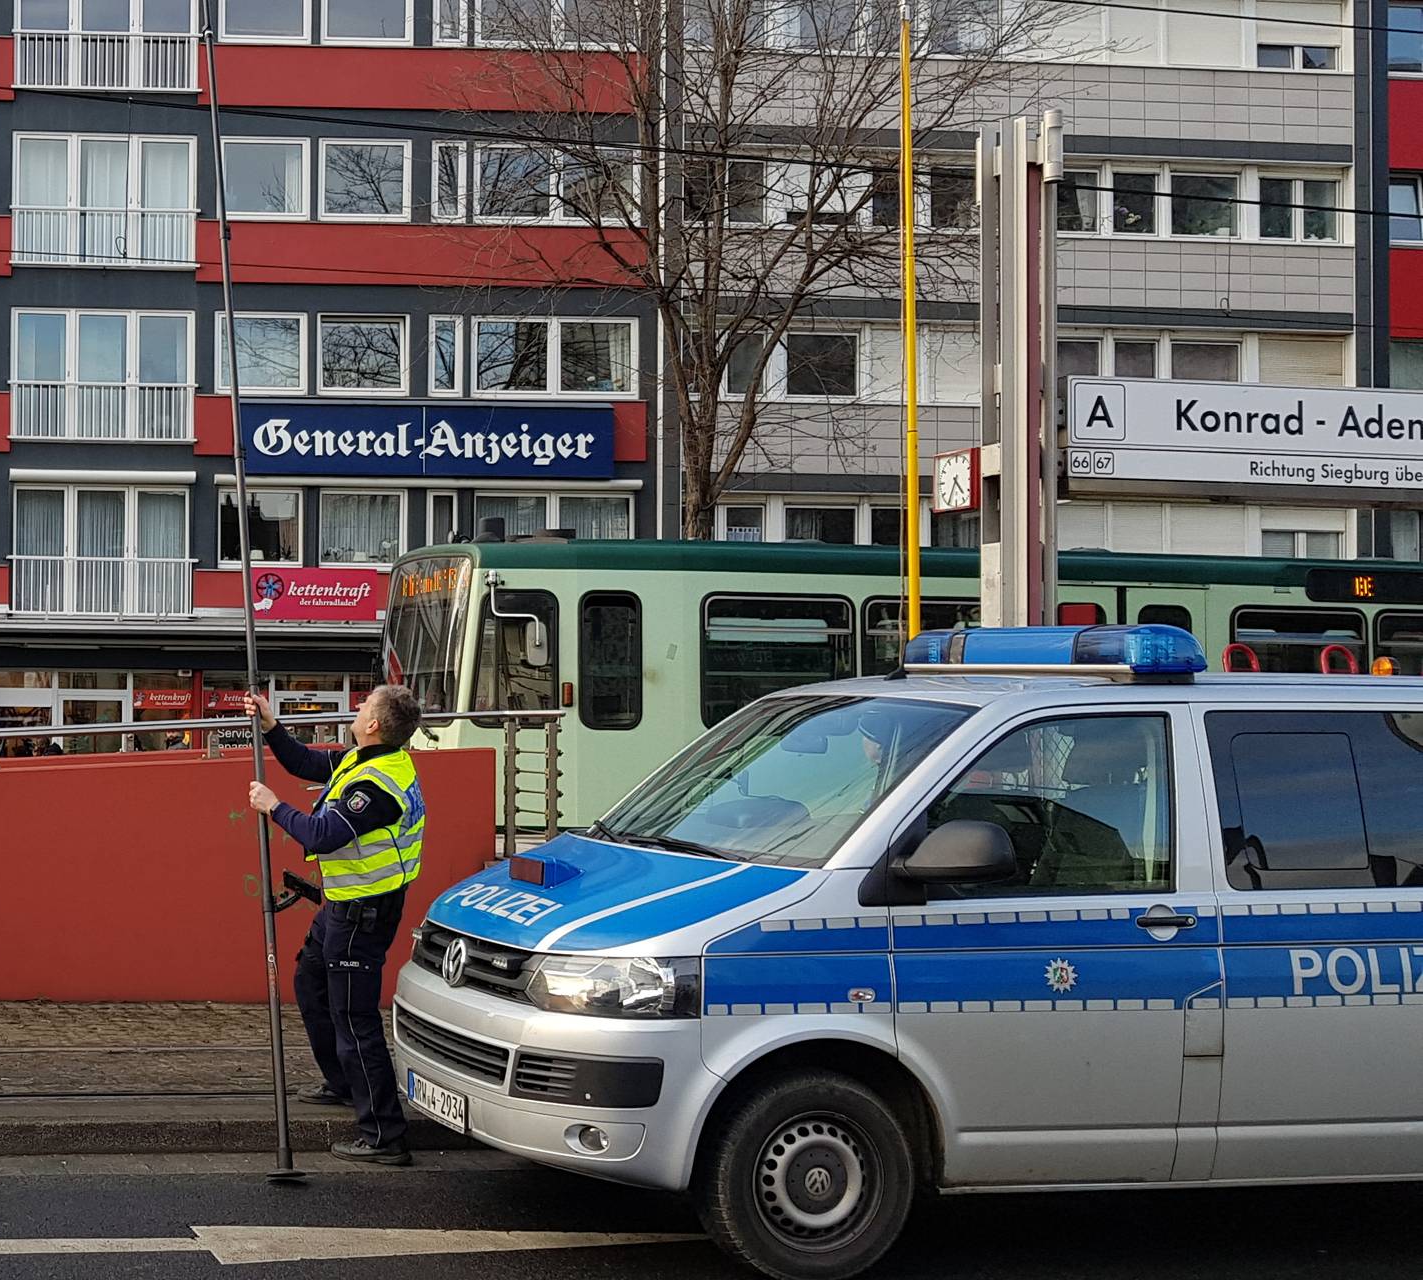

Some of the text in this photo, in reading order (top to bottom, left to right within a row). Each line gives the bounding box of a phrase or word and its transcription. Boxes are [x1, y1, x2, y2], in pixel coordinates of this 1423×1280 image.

[1086, 396, 1114, 428] A
[1176, 399, 1304, 435] Konrad
[1337, 404, 1423, 440] Aden
[252, 418, 595, 466] General-Anzeiger
[1072, 456, 1089, 469] 66
[1096, 457, 1112, 470] 67
[1249, 461, 1423, 486] Richtung Siegburg übe
[287, 581, 372, 602] kettenkraft
[299, 598, 312, 606] der
[149, 692, 192, 705] kettenkraft
[444, 883, 564, 928] POLIZEI
